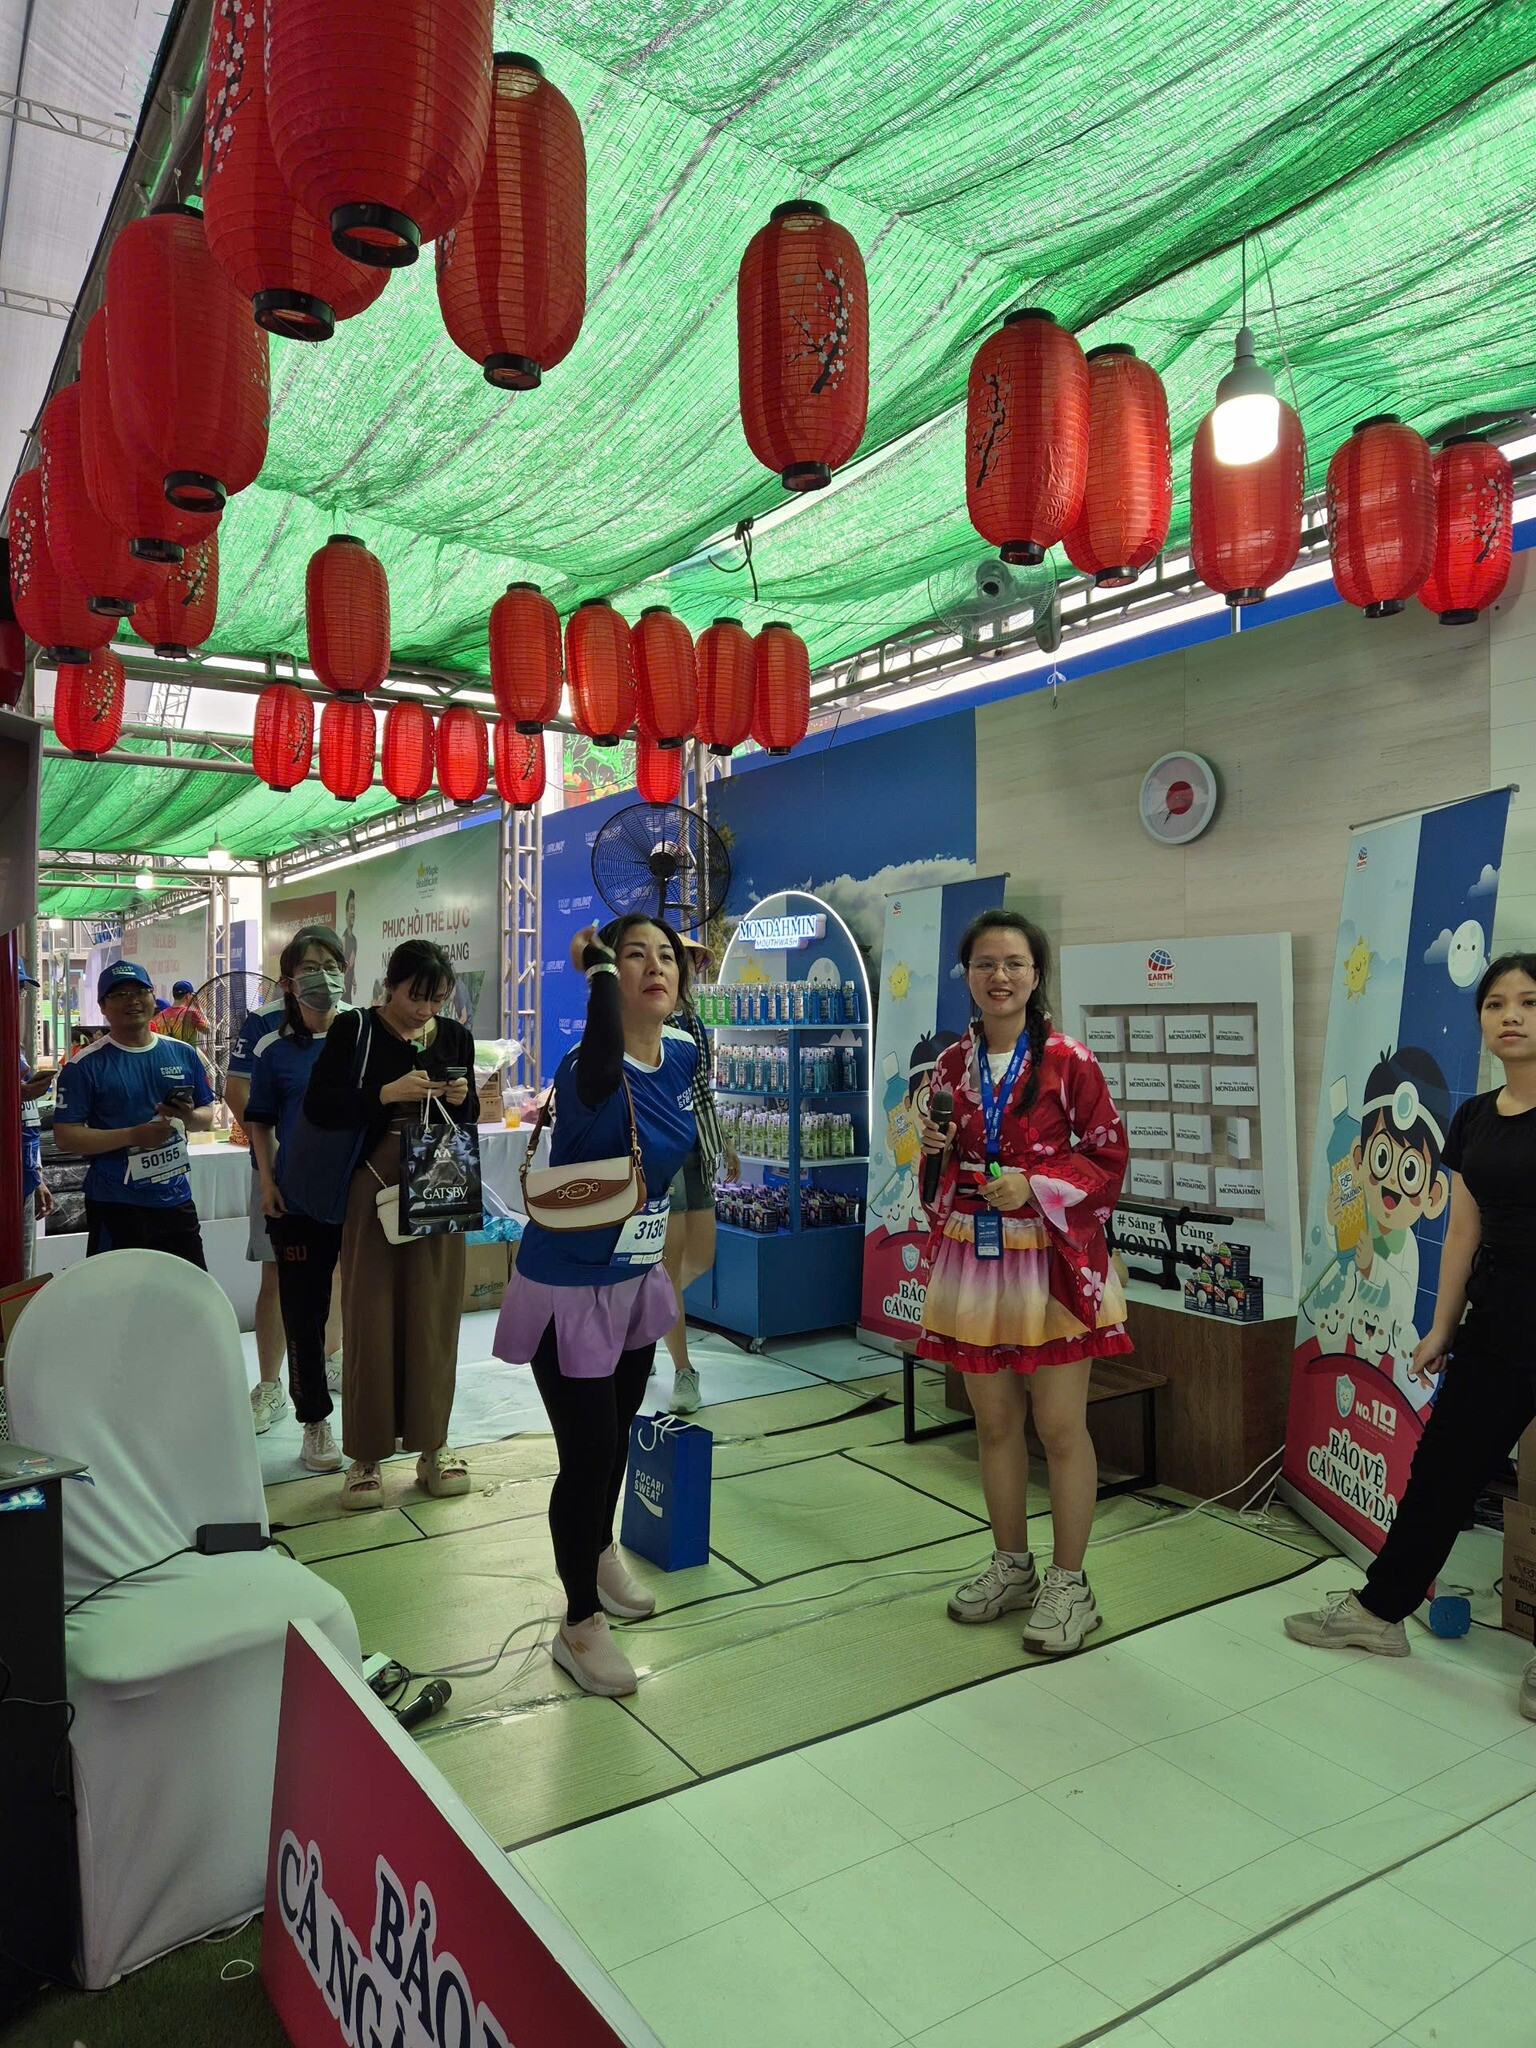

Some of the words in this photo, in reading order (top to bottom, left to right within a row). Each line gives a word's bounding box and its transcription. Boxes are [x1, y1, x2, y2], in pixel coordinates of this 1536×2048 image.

[382, 916, 405, 941] PHỤC
[407, 907, 423, 936] HỒI
[740, 915, 816, 939] MONDAHMIN
[756, 938, 798, 948] MOUTHWASH
[1148, 973, 1173, 981] EARTH
[141, 1147, 181, 1169] 50155
[422, 1186, 469, 1200] GATSBY
[1218, 1187, 1261, 1195] MONDAHMIN
[1128, 1216, 1156, 1235] Sáng
[1180, 1220, 1214, 1244] Cùng
[473, 1281, 504, 1294] Merino
[884, 1296, 900, 1316] CẢ
[1330, 1433, 1360, 1471] BẢO
[1363, 1455, 1384, 1494] VỆ
[634, 1480, 661, 1502] SWEAT
[635, 1469, 665, 1494] POCARI
[1309, 1450, 1327, 1482] CẢ
[1329, 1464, 1373, 1512] NGÀY
[1373, 1496, 1397, 1527] DÀ
[281, 1842, 321, 1974] CẢ
[375, 1870, 471, 2048] BẢO
